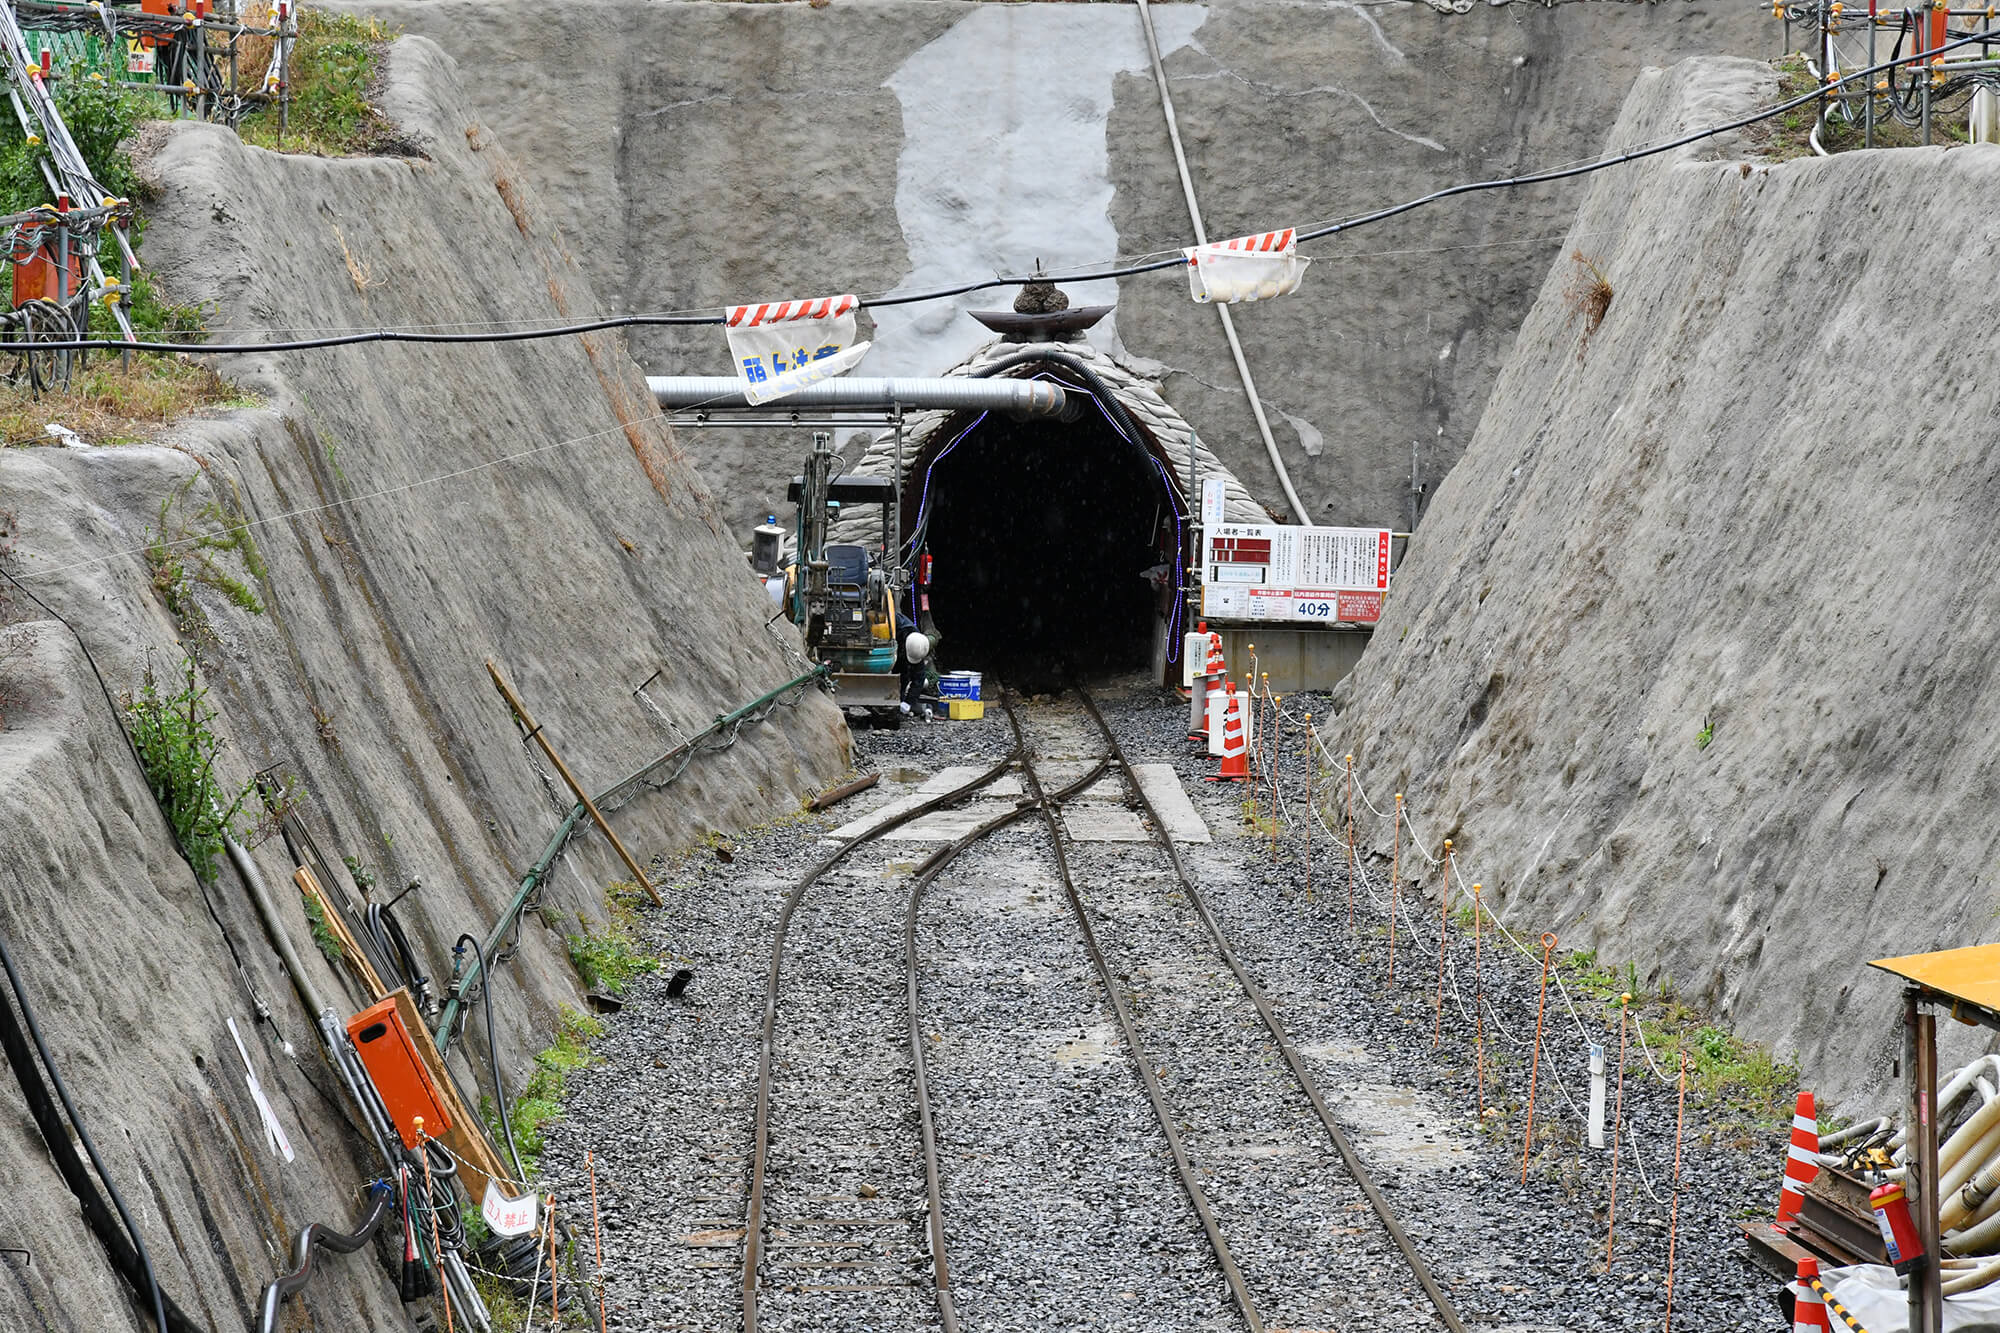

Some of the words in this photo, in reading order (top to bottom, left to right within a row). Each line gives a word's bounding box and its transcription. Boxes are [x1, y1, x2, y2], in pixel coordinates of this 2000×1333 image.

[1298, 602, 1330, 617] 40分
[486, 1199, 528, 1229] 立入禁止
